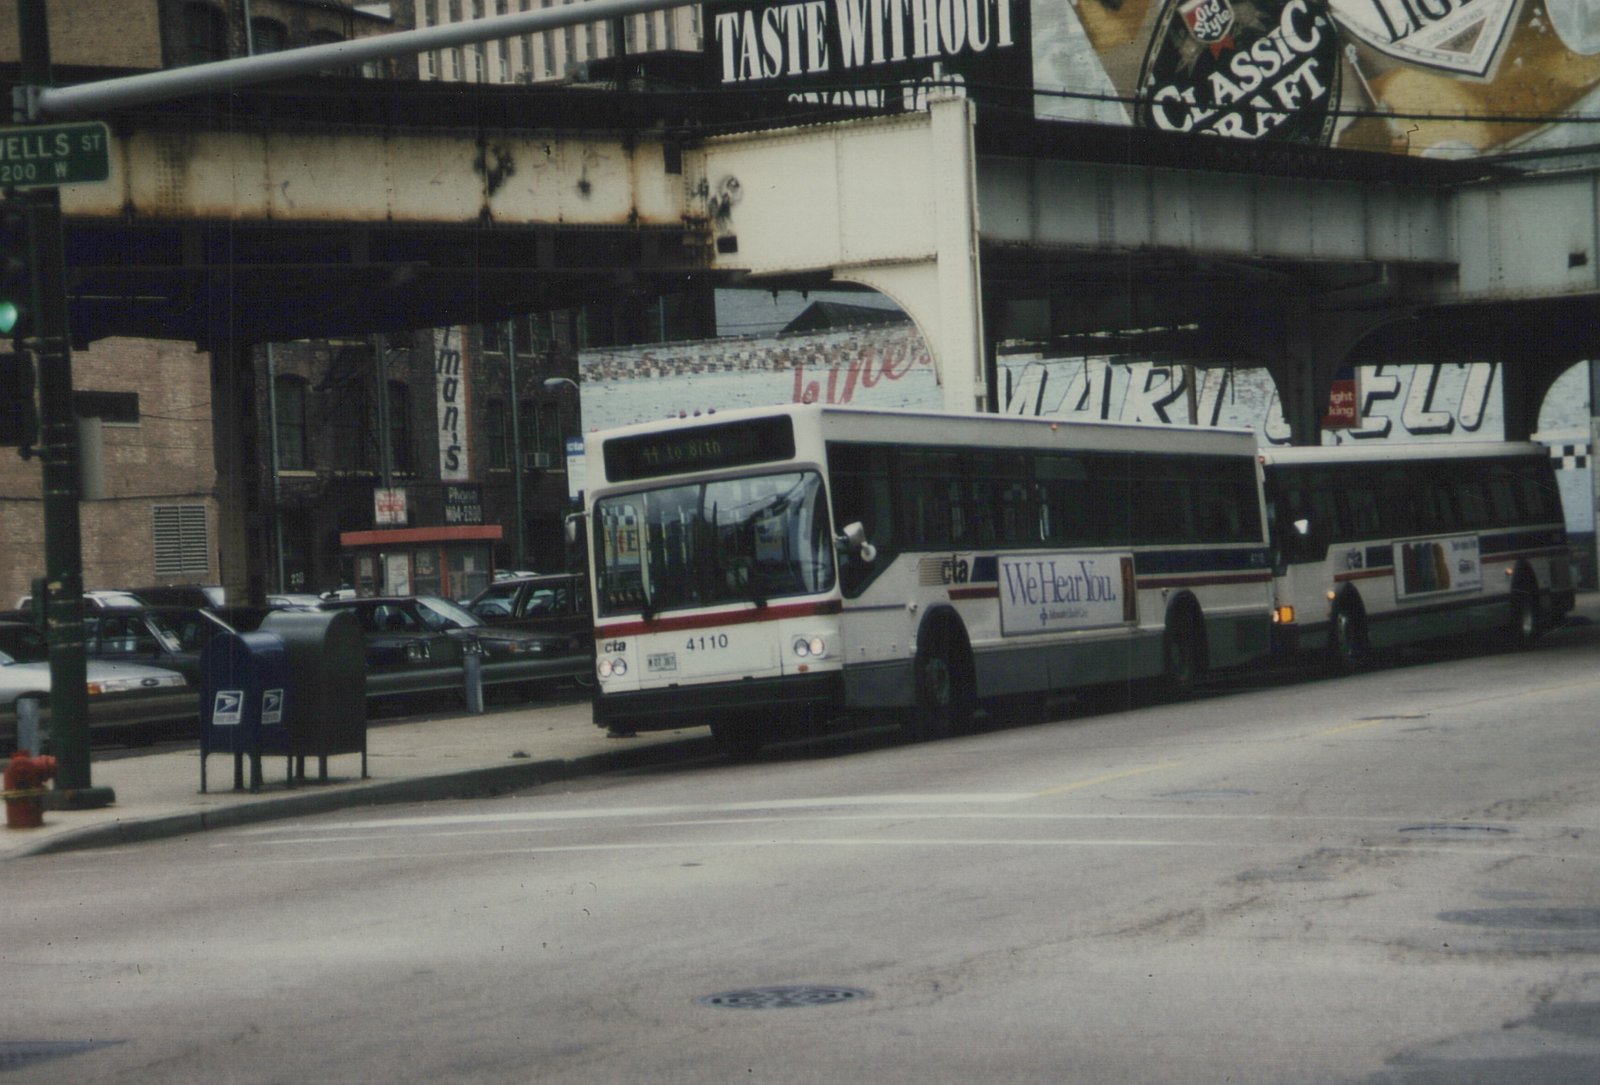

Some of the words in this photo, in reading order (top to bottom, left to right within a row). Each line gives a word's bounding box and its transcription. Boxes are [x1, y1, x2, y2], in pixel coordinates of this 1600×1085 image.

[1194, 10, 1232, 39] Style
[1195, 0, 1220, 22] Old
[715, 1, 830, 83] TASTE
[836, 0, 1014, 68] WITHOUT
[1152, 0, 1321, 133] CLASSIC
[1200, 57, 1326, 139] RAFT
[0, 133, 70, 160] ELLS
[81, 134, 100, 151] ST
[1, 163, 36, 182] 200
[54, 161, 68, 178] W
[1329, 390, 1353, 405] ight
[1328, 404, 1355, 419] king
[941, 554, 969, 585] cta
[1003, 561, 1037, 606] We
[1036, 560, 1083, 605] Hear
[1078, 560, 1117, 602] You.
[604, 640, 627, 653] cta
[686, 633, 729, 651] 4110
